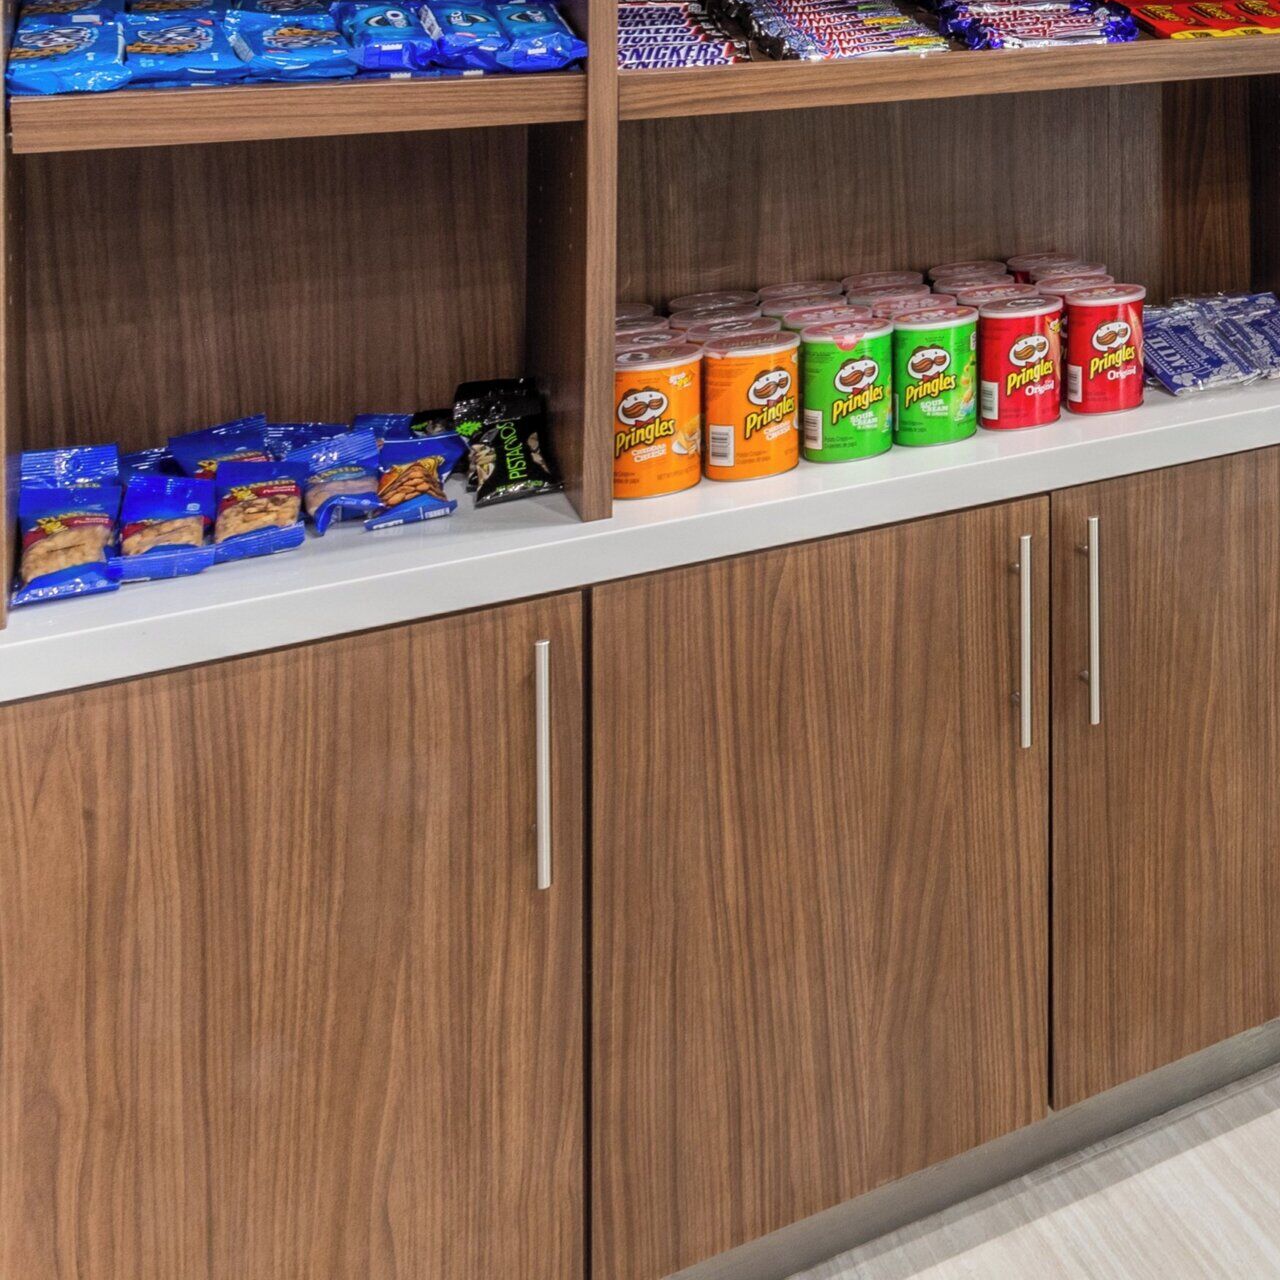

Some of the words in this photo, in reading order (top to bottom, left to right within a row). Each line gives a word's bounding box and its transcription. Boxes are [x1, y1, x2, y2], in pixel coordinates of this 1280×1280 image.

[618, 43, 724, 60] SNICKERS
[1007, 359, 1053, 396] Pringles
[1090, 346, 1135, 380] Pringles
[832, 385, 884, 425] Pringles
[905, 373, 956, 410] Pringles
[745, 396, 795, 439] Pringles
[851, 411, 873, 422] SOUR
[615, 419, 675, 458] Pringles
